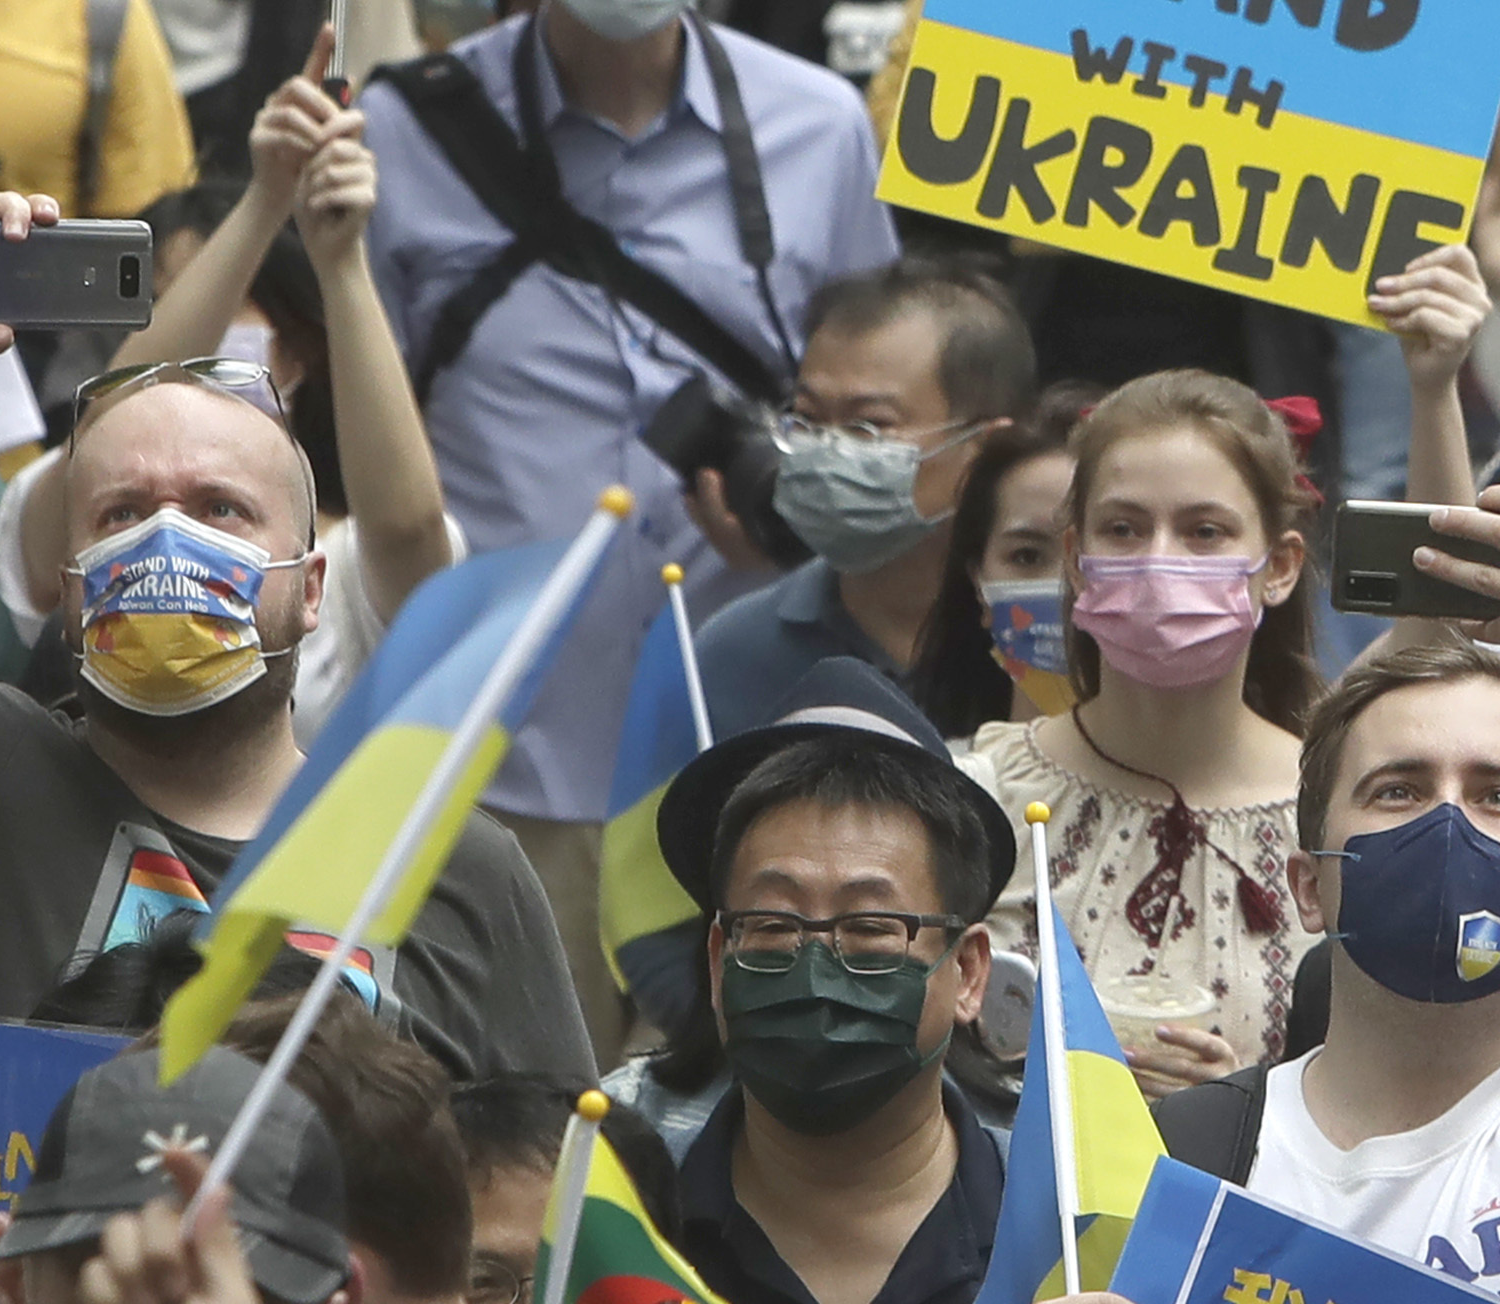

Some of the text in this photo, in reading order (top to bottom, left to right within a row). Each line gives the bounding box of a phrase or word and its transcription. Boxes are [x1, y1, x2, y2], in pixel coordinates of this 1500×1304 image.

[1070, 28, 1285, 130] WITH
[896, 66, 1466, 301] UKRAINE
[123, 556, 210, 582] STAND WITH
[156, 599, 183, 611] Can
